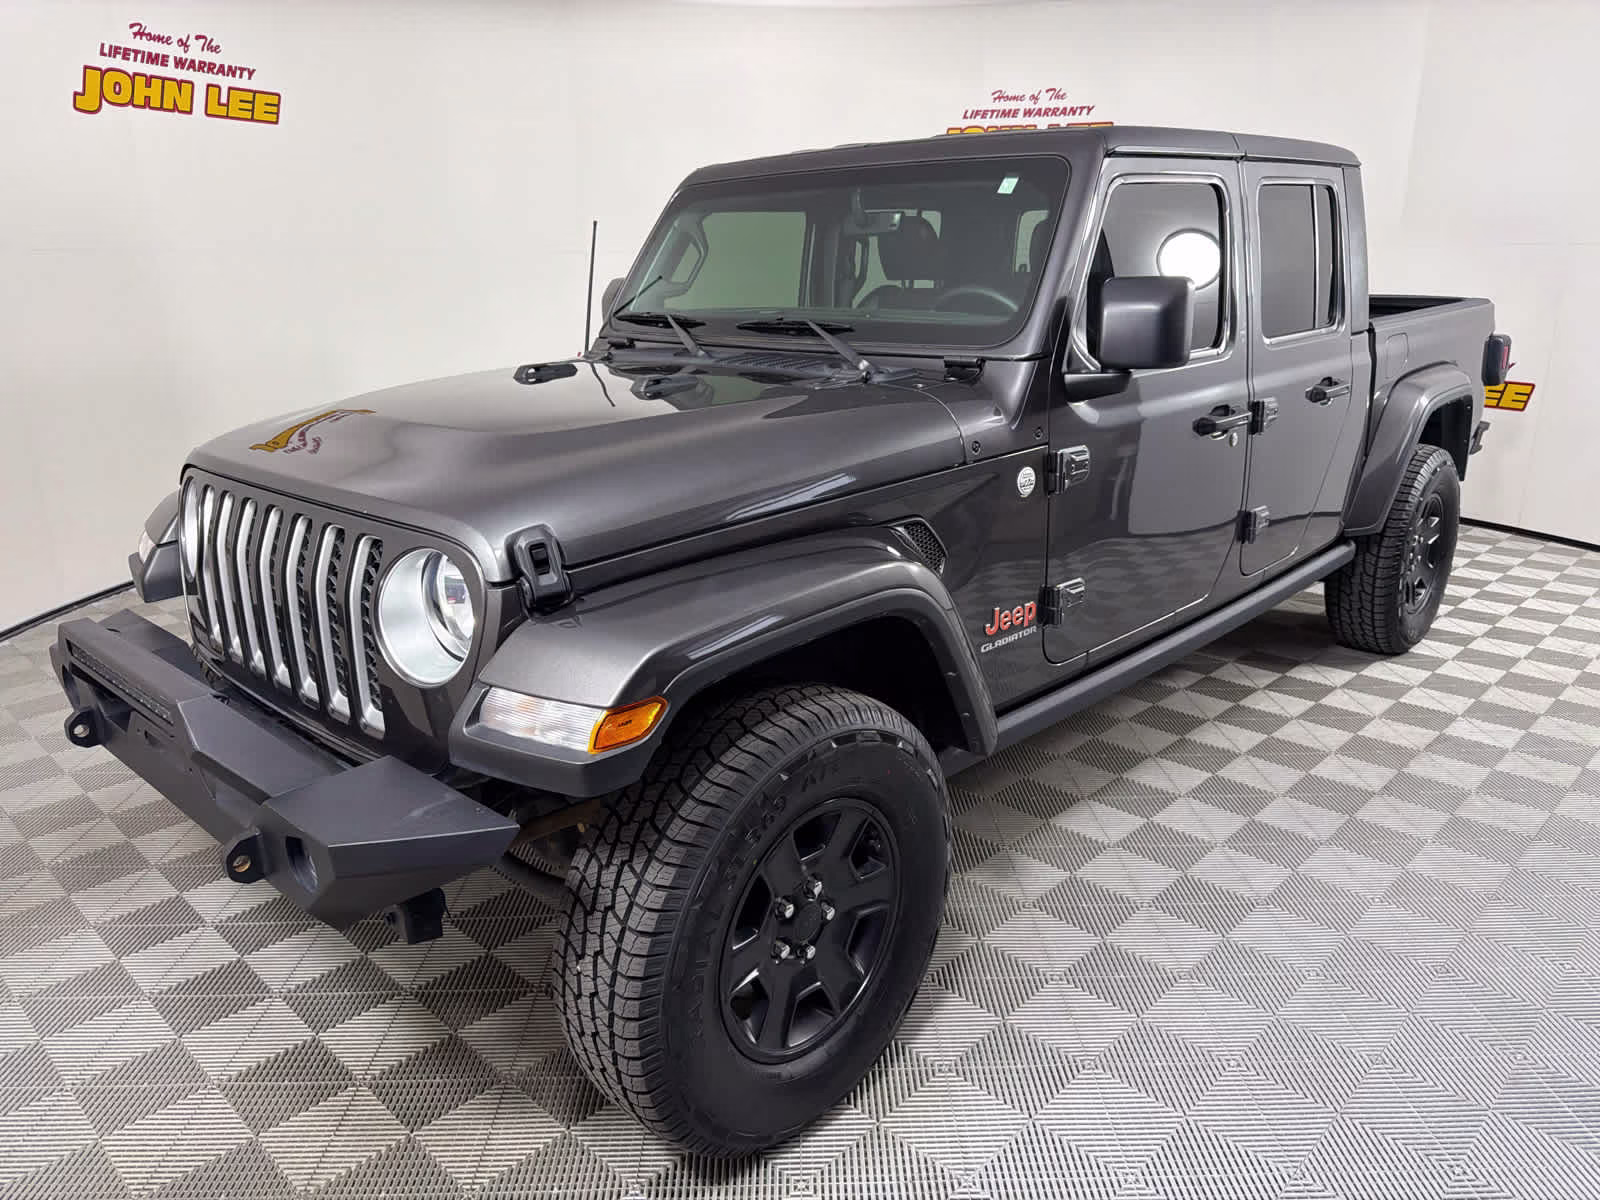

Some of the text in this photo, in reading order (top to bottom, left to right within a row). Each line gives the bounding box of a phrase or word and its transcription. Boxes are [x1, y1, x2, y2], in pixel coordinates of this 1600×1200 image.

[128, 22, 222, 54] Home of The
[100, 43, 256, 80] LIFETIME WARRANTY
[73, 65, 281, 124] JOHN LEE
[991, 88, 1068, 104] Home of The
[962, 105, 1095, 120] LIFETIME WARRANTY
[1484, 381, 1535, 412] EE
[984, 601, 1037, 635] Jeep
[980, 625, 1037, 653] GLADIATOR
